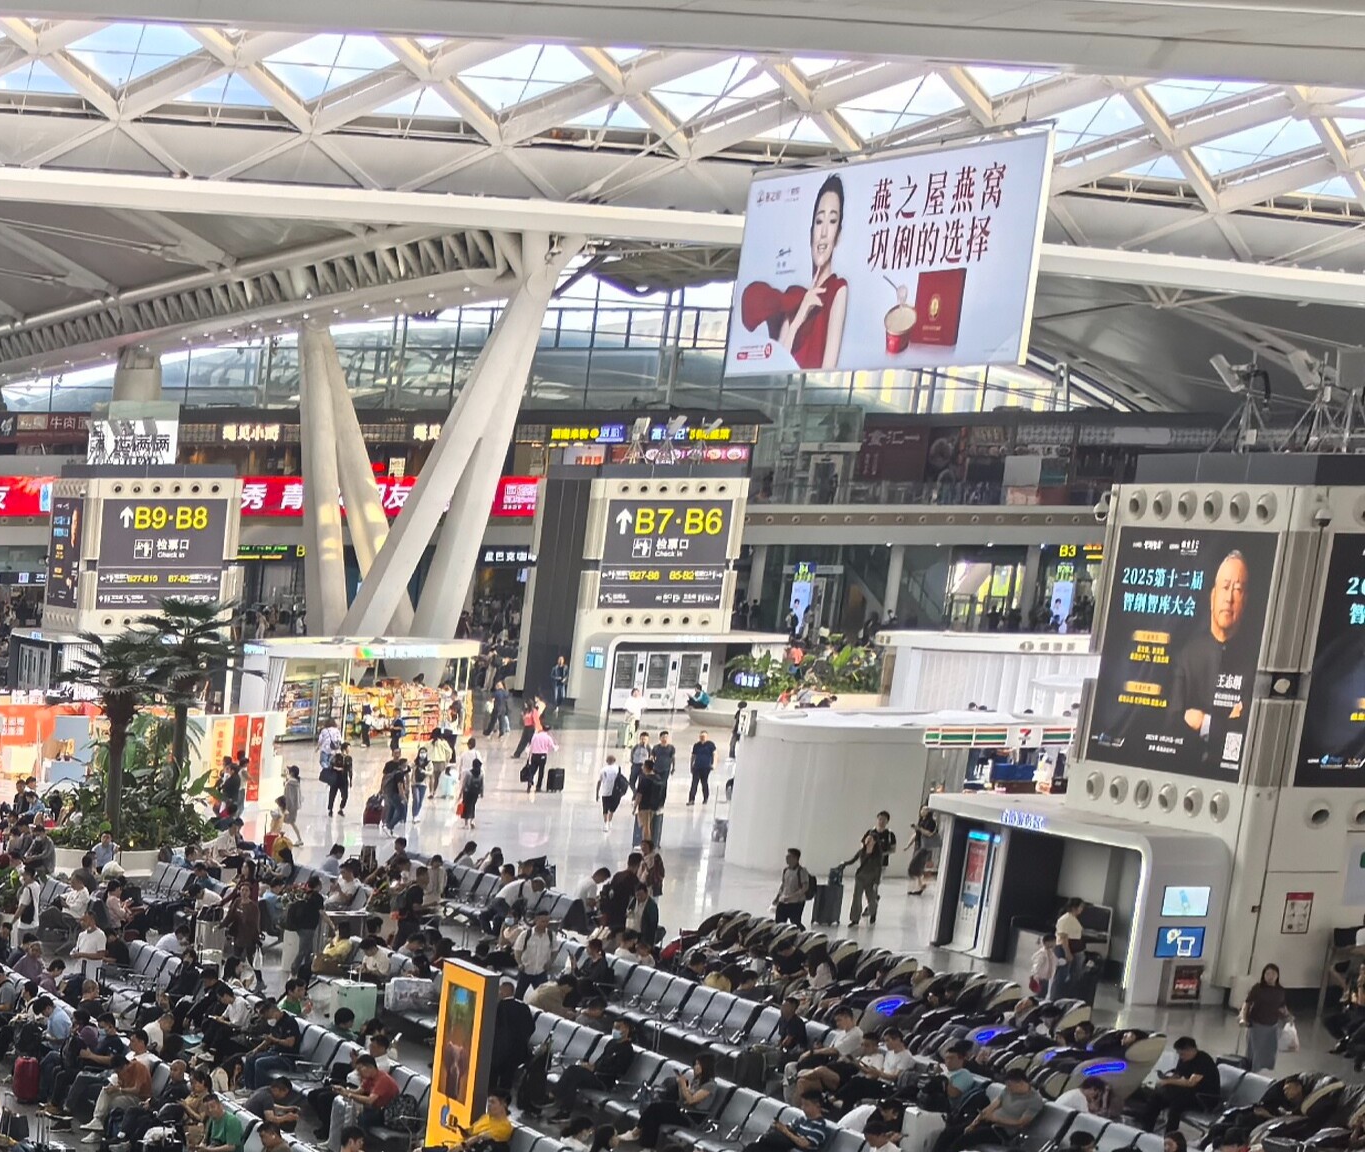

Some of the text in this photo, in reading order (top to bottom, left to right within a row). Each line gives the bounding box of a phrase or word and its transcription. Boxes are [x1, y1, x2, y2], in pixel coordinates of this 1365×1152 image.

[868, 162, 1007, 224] 燕之屋燕窝
[867, 216, 991, 272] 巩俐的选择
[156, 538, 190, 550] 检票口
[656, 538, 689, 550] 检票口
[157, 551, 177, 559] Check
[1122, 566, 1204, 591] 2025第十二届
